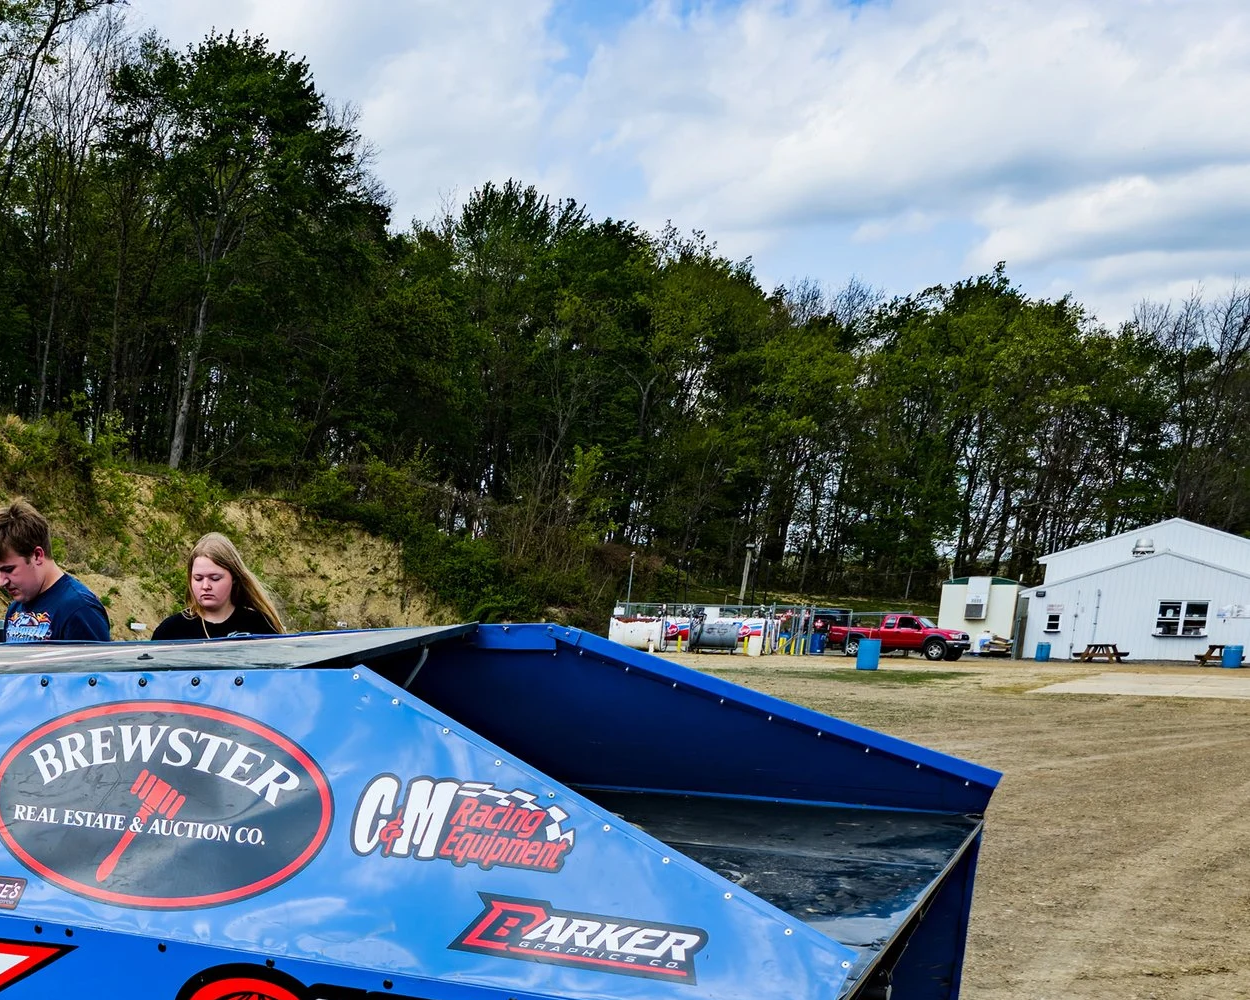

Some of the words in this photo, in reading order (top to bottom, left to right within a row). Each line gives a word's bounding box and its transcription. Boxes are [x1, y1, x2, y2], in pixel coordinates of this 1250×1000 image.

[29, 725, 300, 807] BREWSTER
[13, 804, 59, 824] REAL
[63, 810, 126, 831] ESTATE
[129, 816, 144, 833] &
[147, 818, 232, 842] AUCTION
[235, 826, 266, 846] CO.
[450, 797, 547, 839] Racing
[440, 826, 568, 869] Equipment
[462, 900, 700, 962] BARKER
[518, 941, 636, 963] GRAPHICS
[649, 960, 679, 969] CO.
